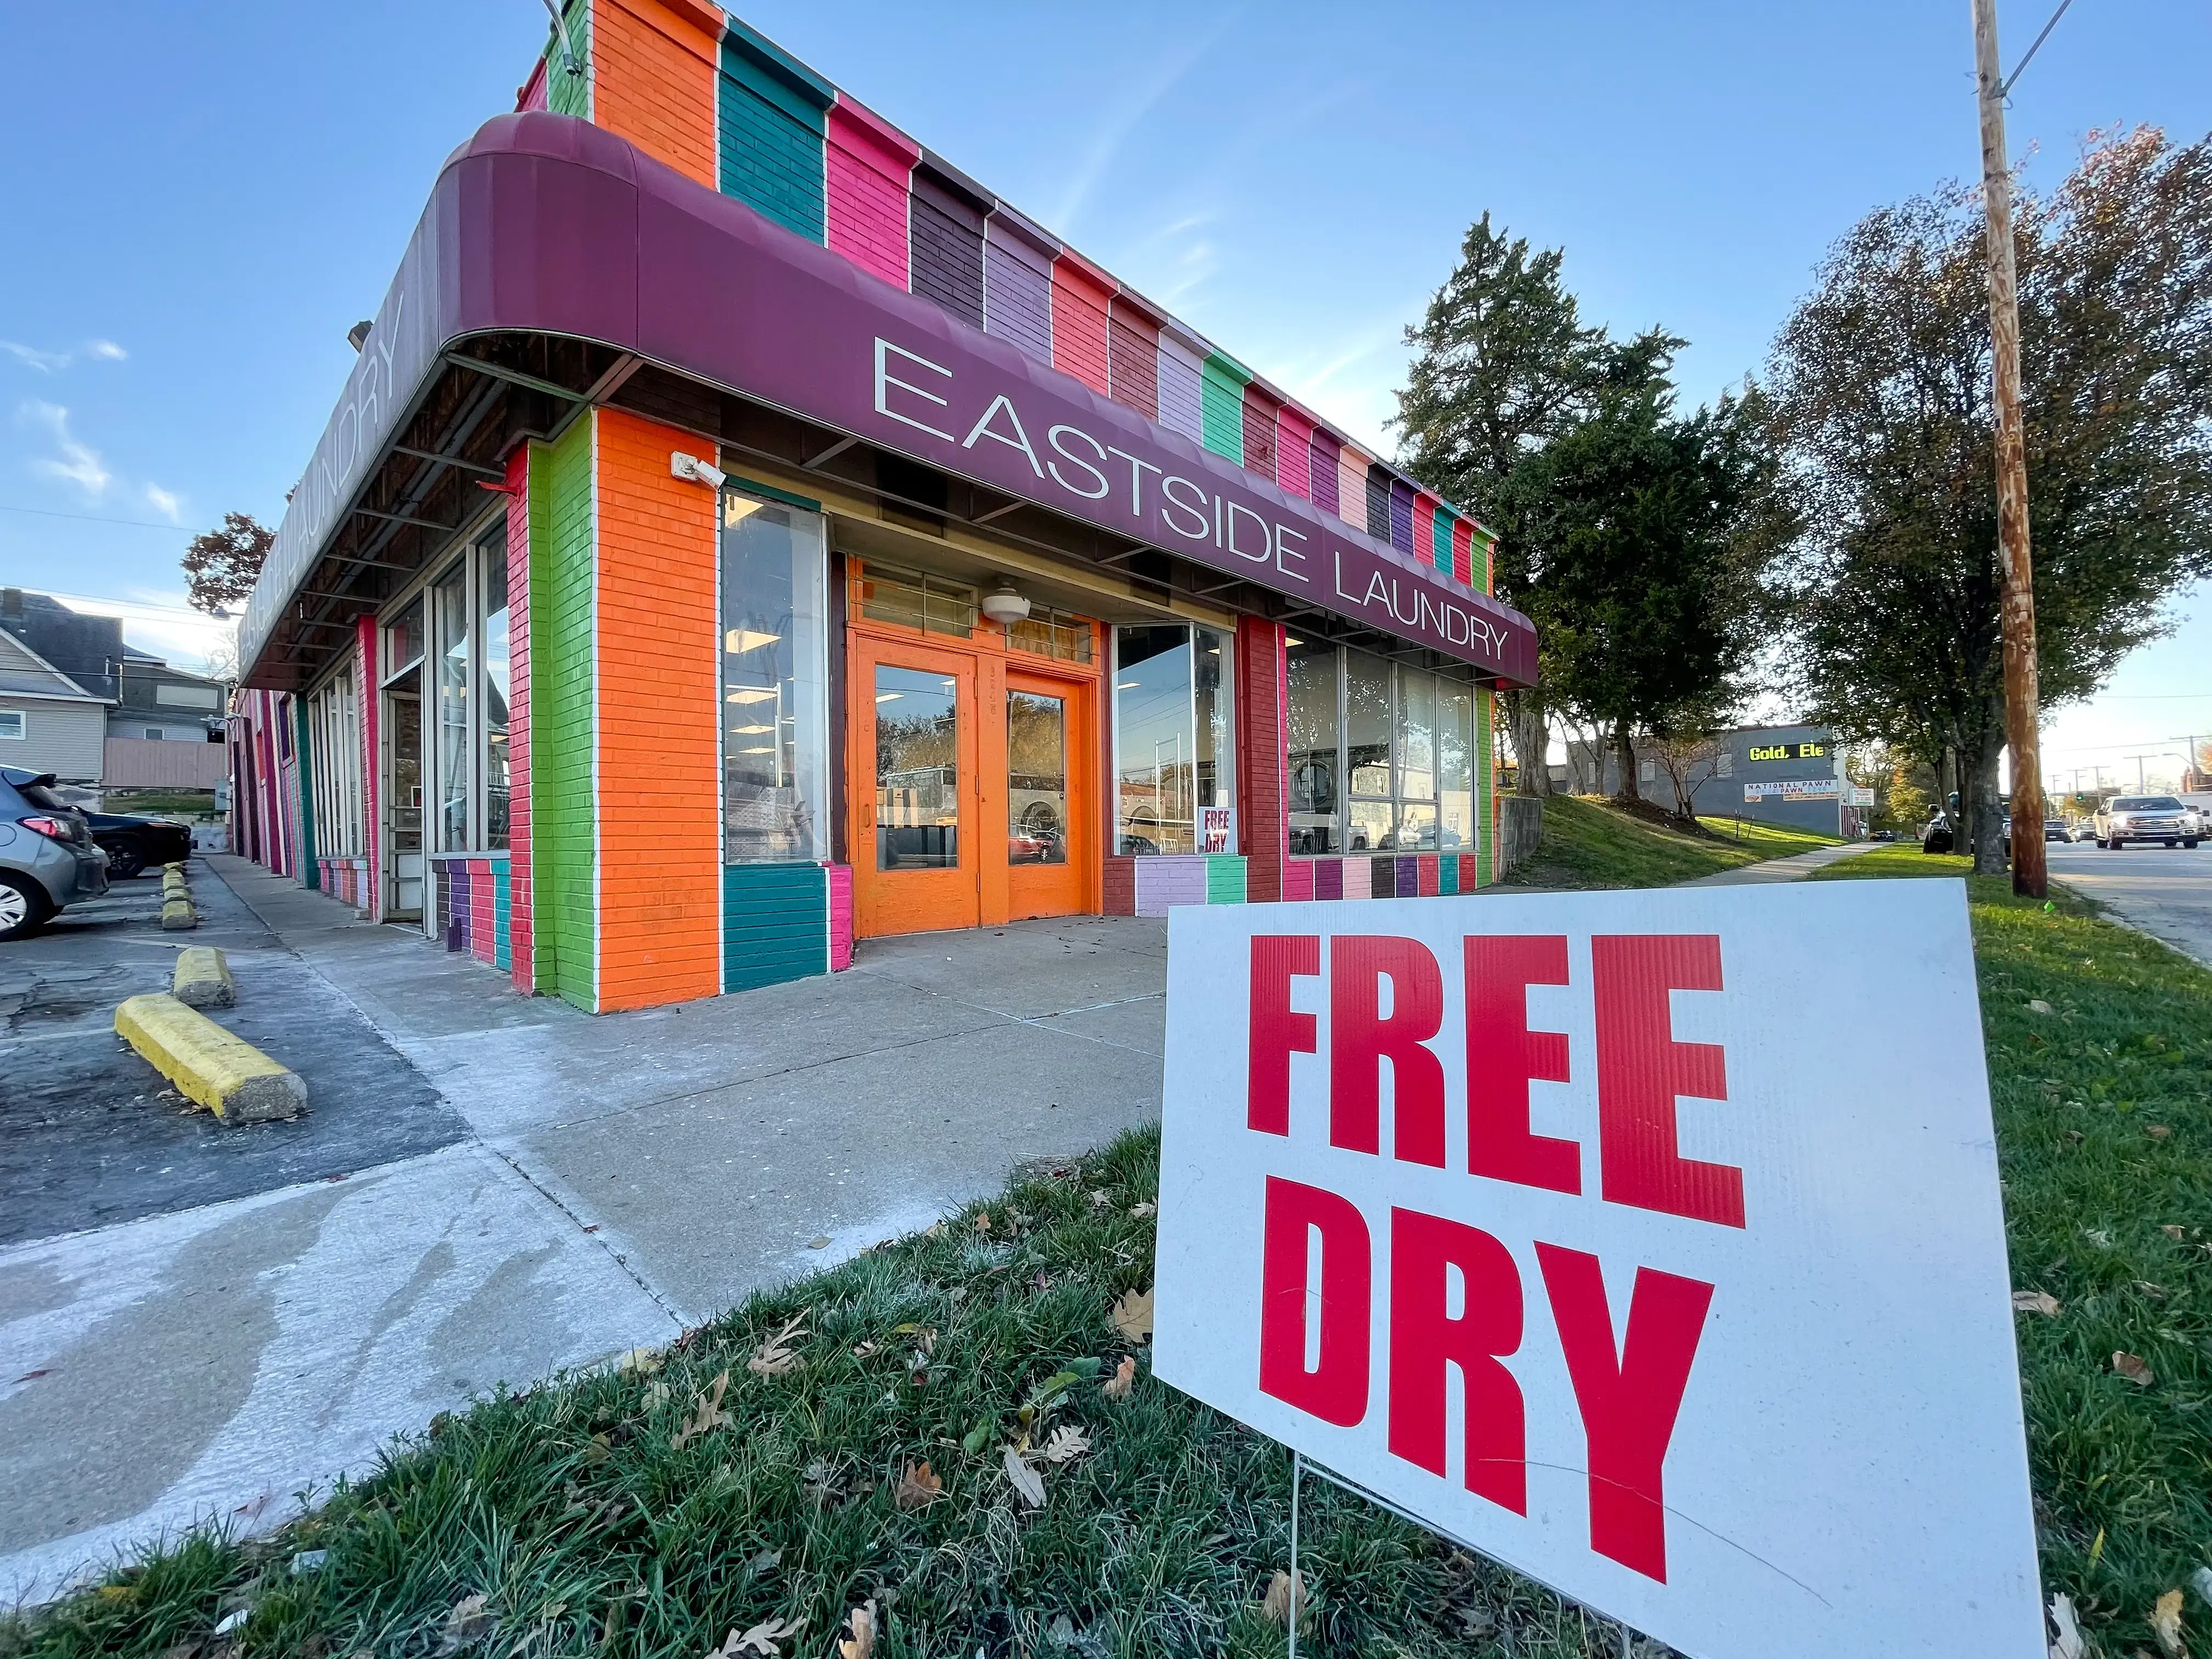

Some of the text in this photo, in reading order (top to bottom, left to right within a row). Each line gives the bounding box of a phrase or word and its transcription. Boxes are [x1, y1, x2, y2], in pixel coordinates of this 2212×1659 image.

[287, 290, 404, 578] LAUNDRY
[874, 336, 1509, 661] EASTSIDE LAUNDRY
[1204, 810, 1229, 830] FREE
[1204, 833, 1227, 853] DRY
[1750, 745, 1790, 760] Gold,
[1248, 935, 1745, 1228] FREE
[1260, 1176, 1714, 1584] DRY
